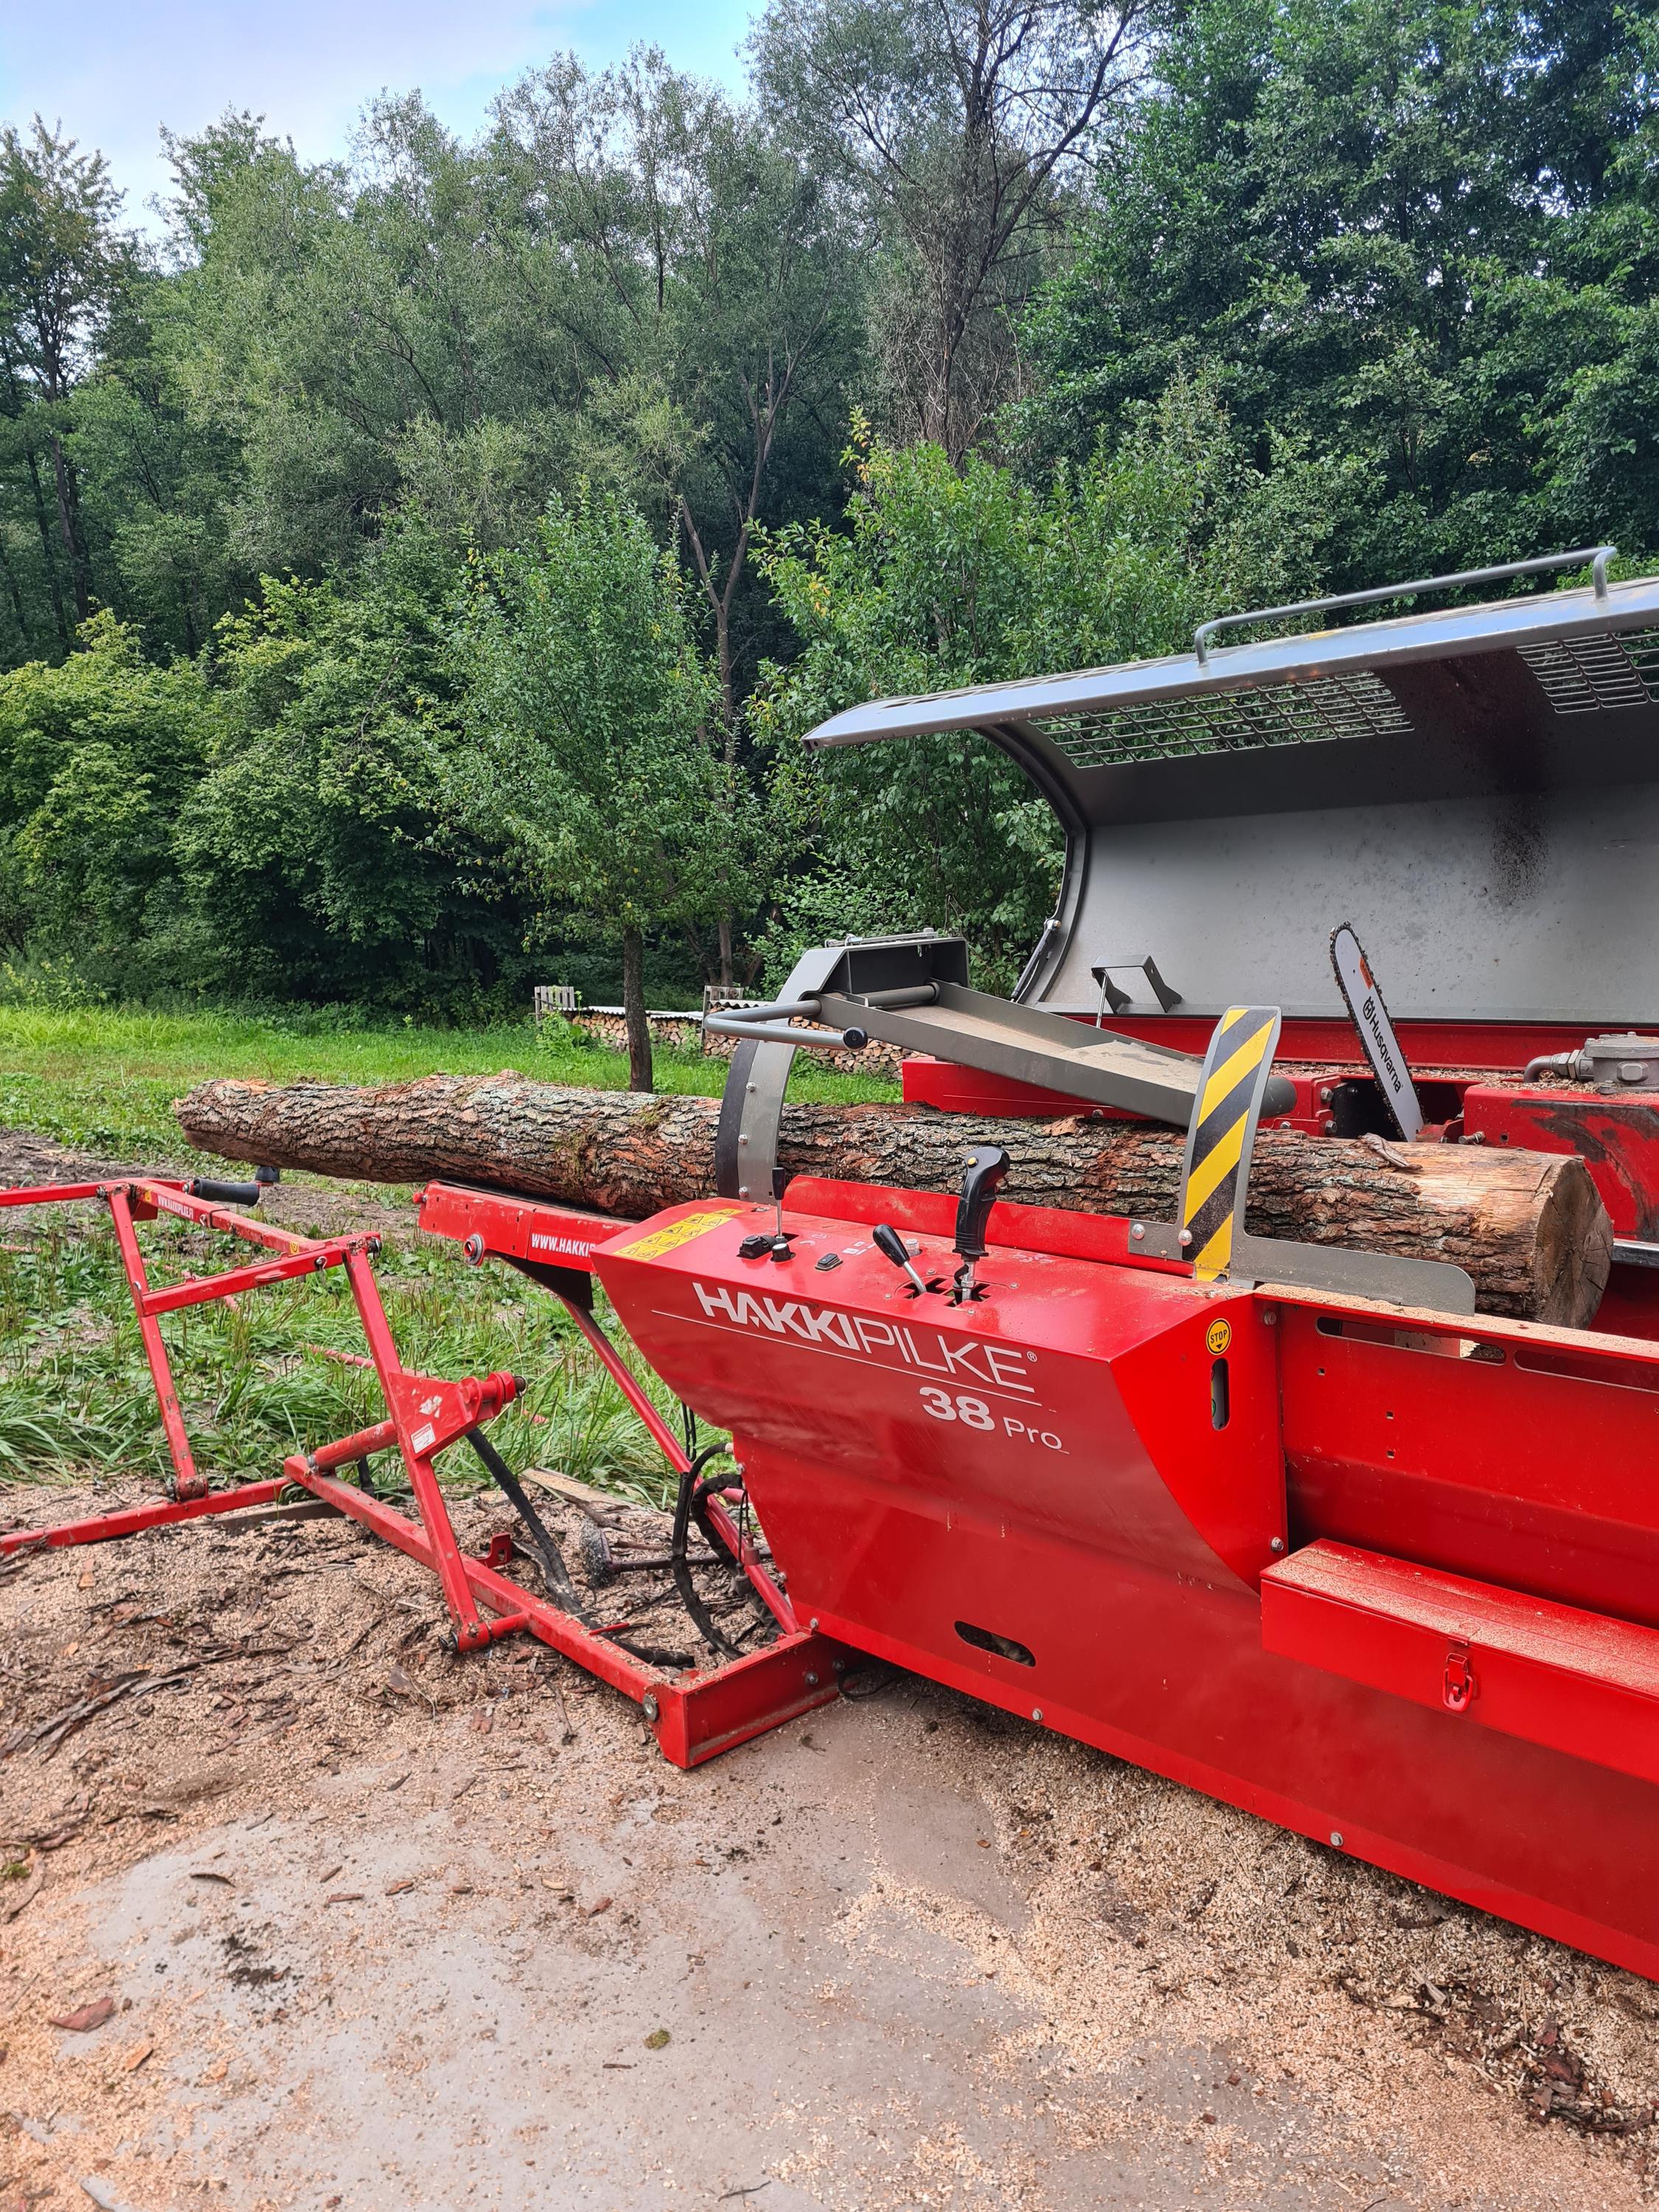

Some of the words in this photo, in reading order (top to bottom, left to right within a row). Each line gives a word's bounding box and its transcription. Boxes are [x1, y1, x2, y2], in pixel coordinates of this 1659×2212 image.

[1369, 1012, 1402, 1093] Husqvarna
[1210, 1329, 1228, 1344] STOP
[919, 1386, 995, 1431] 38
[1002, 1416, 1062, 1450] Pro
